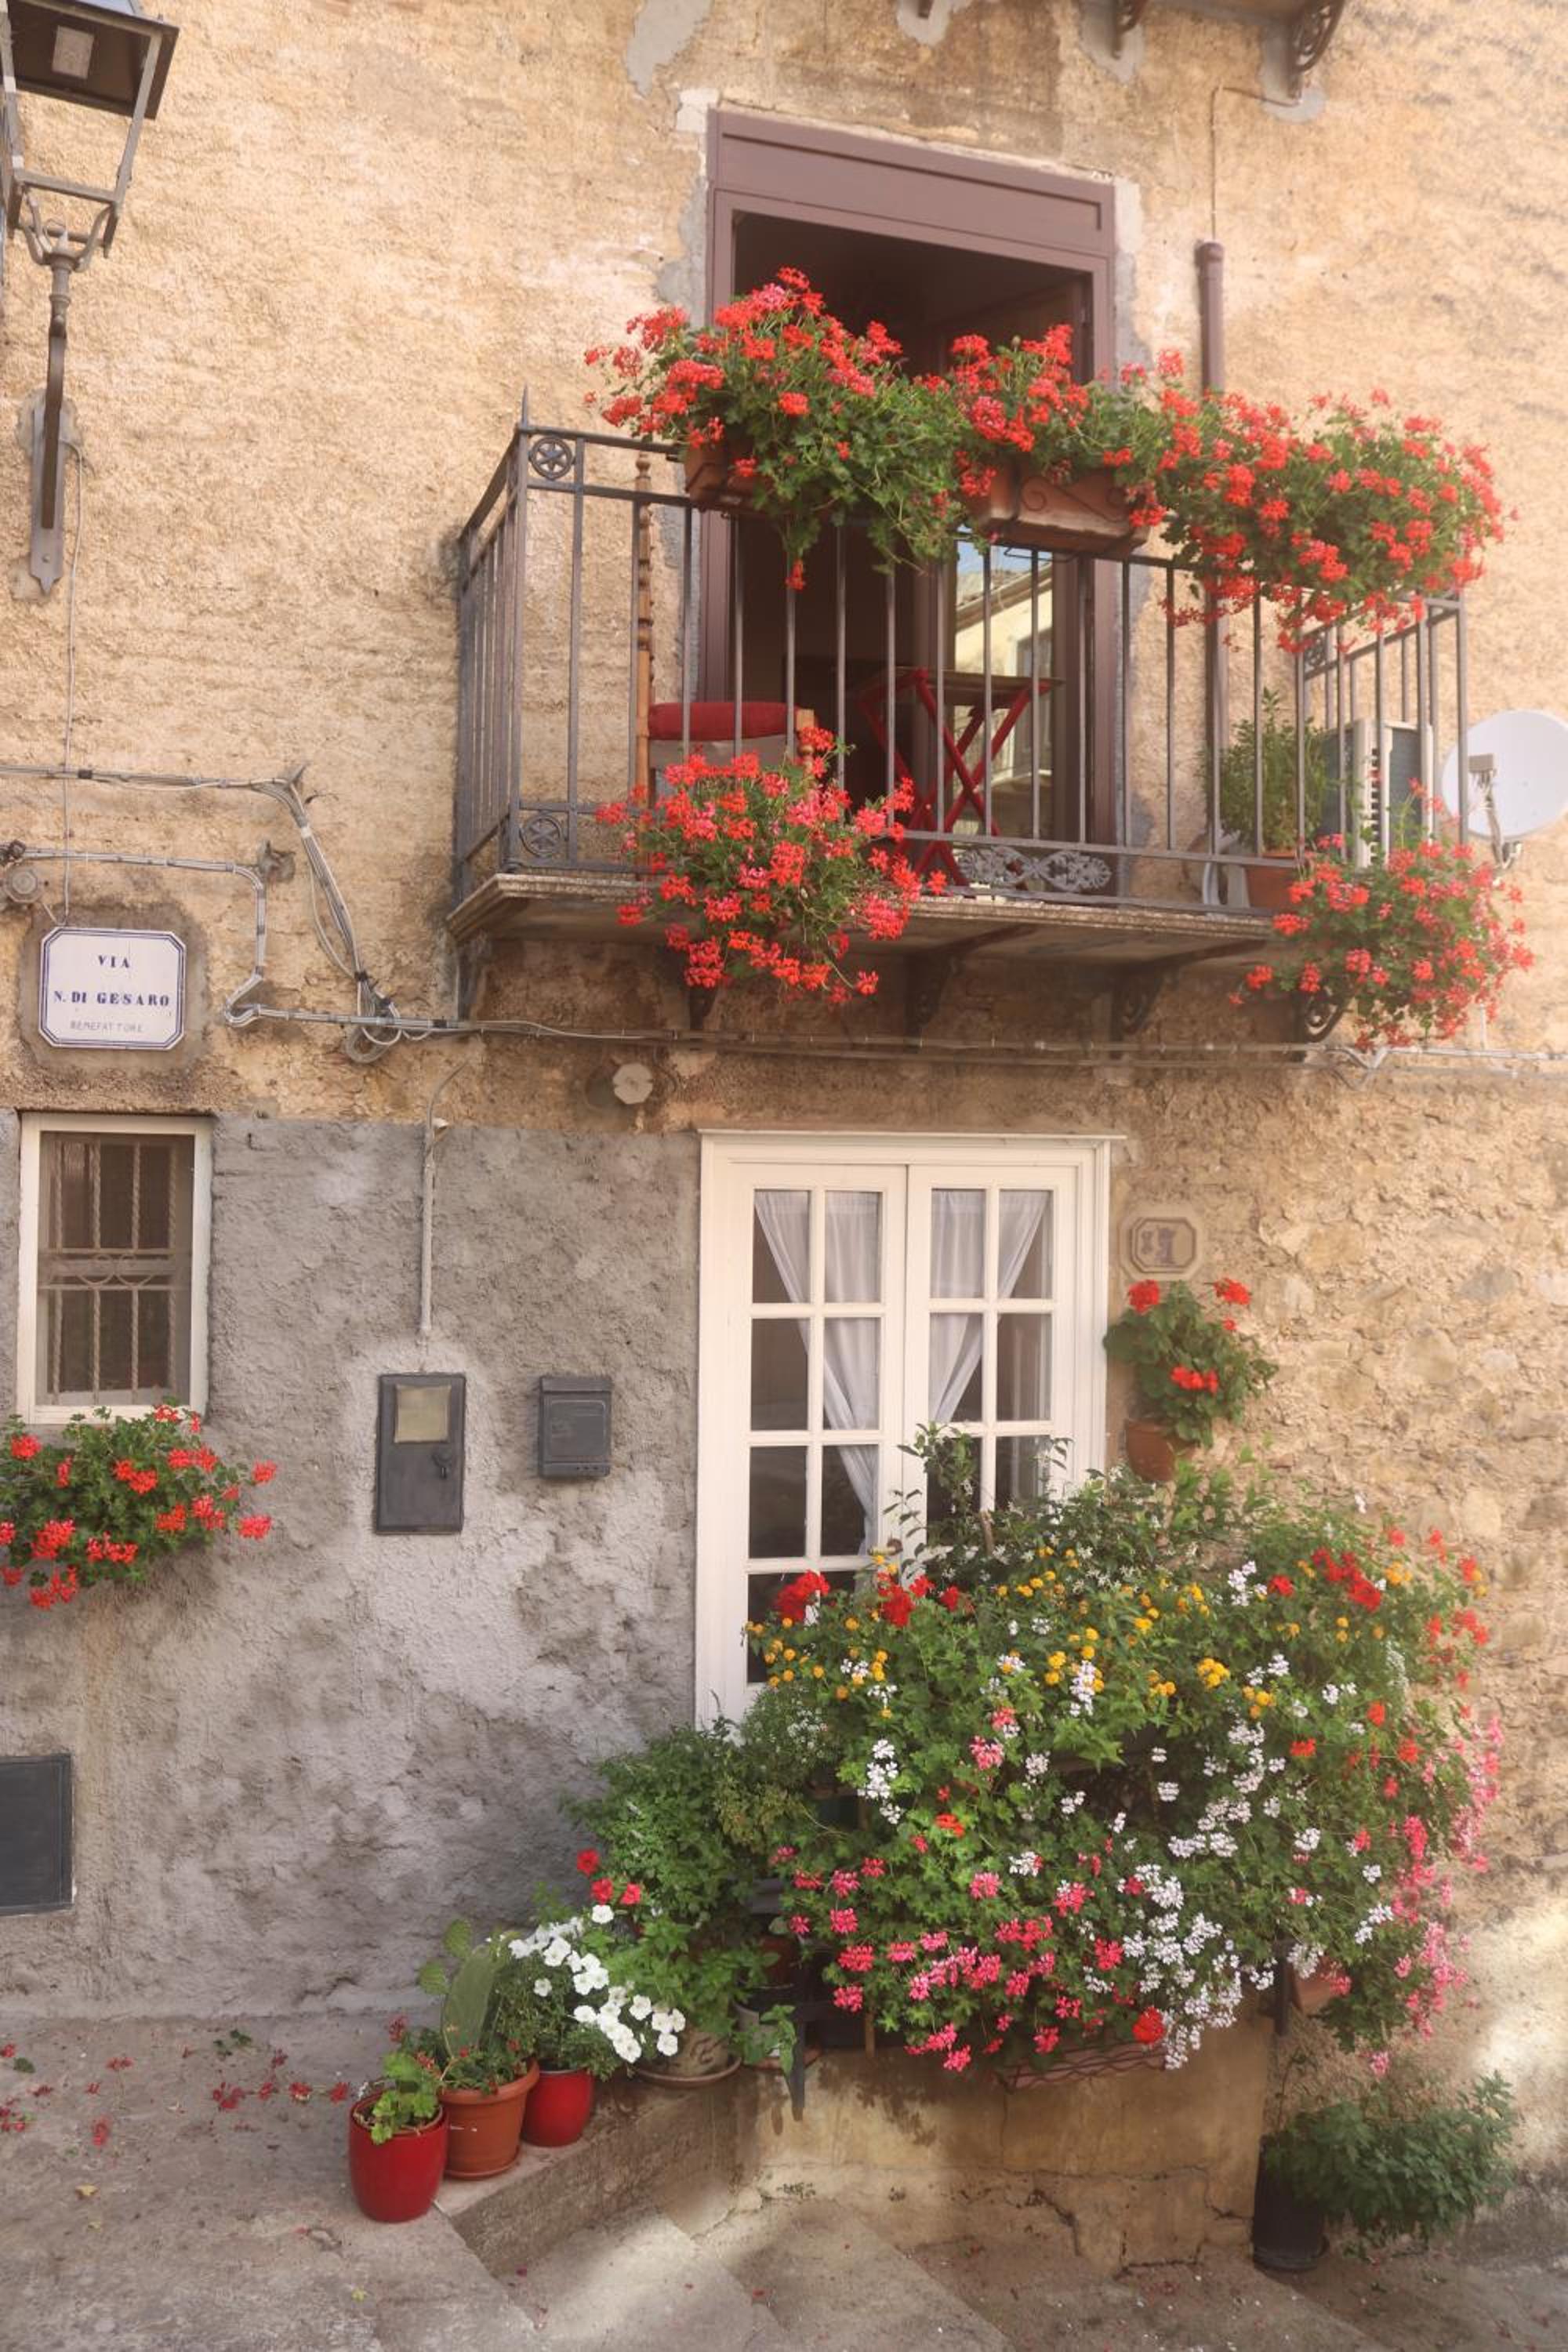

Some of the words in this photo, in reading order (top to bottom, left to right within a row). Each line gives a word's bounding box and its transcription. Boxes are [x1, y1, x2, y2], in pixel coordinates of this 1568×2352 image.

[98, 955, 130, 969] VIA
[71, 991, 87, 1004] DI
[96, 992, 169, 1007] GESARO
